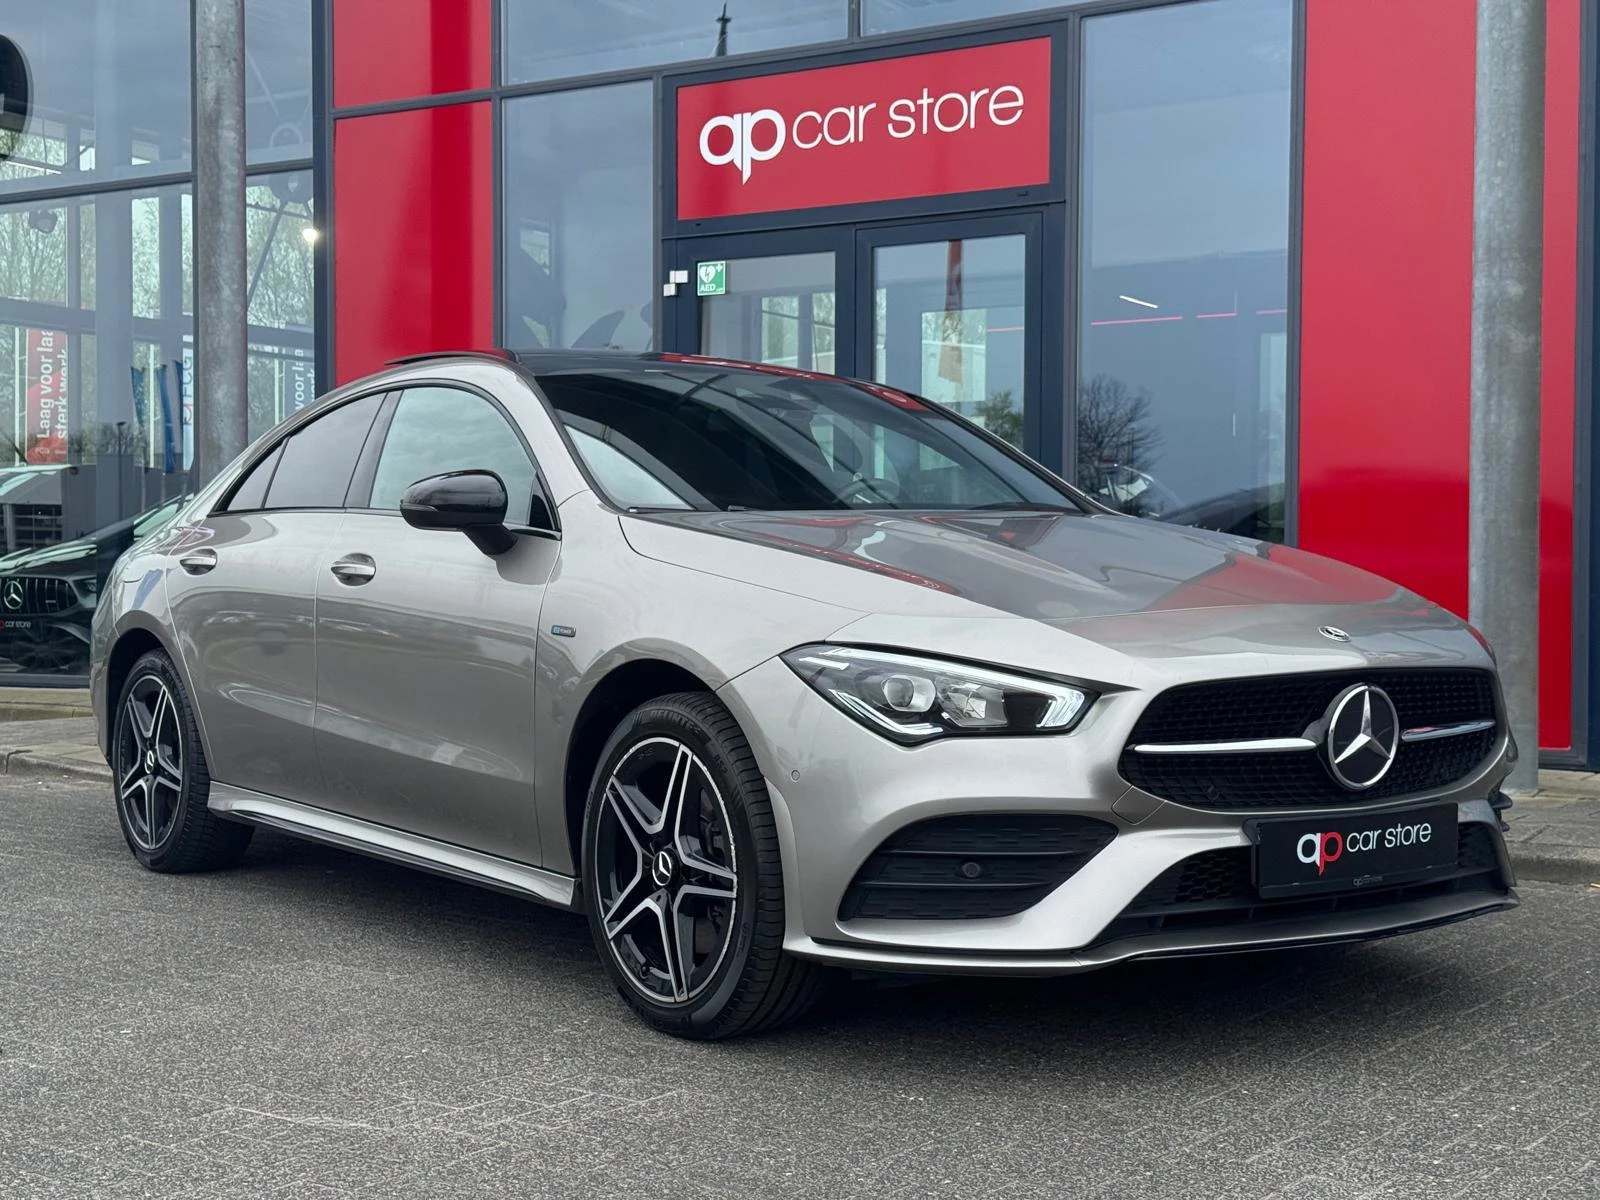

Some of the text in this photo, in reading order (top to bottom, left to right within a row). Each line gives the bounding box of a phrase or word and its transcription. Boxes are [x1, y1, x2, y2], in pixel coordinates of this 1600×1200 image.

[699, 85, 1025, 185] ap car store
[700, 283, 716, 292] AED
[40, 354, 53, 397] voor
[295, 373, 305, 410] voor
[37, 398, 54, 439] Laag
[1296, 823, 1432, 876] ap car store
